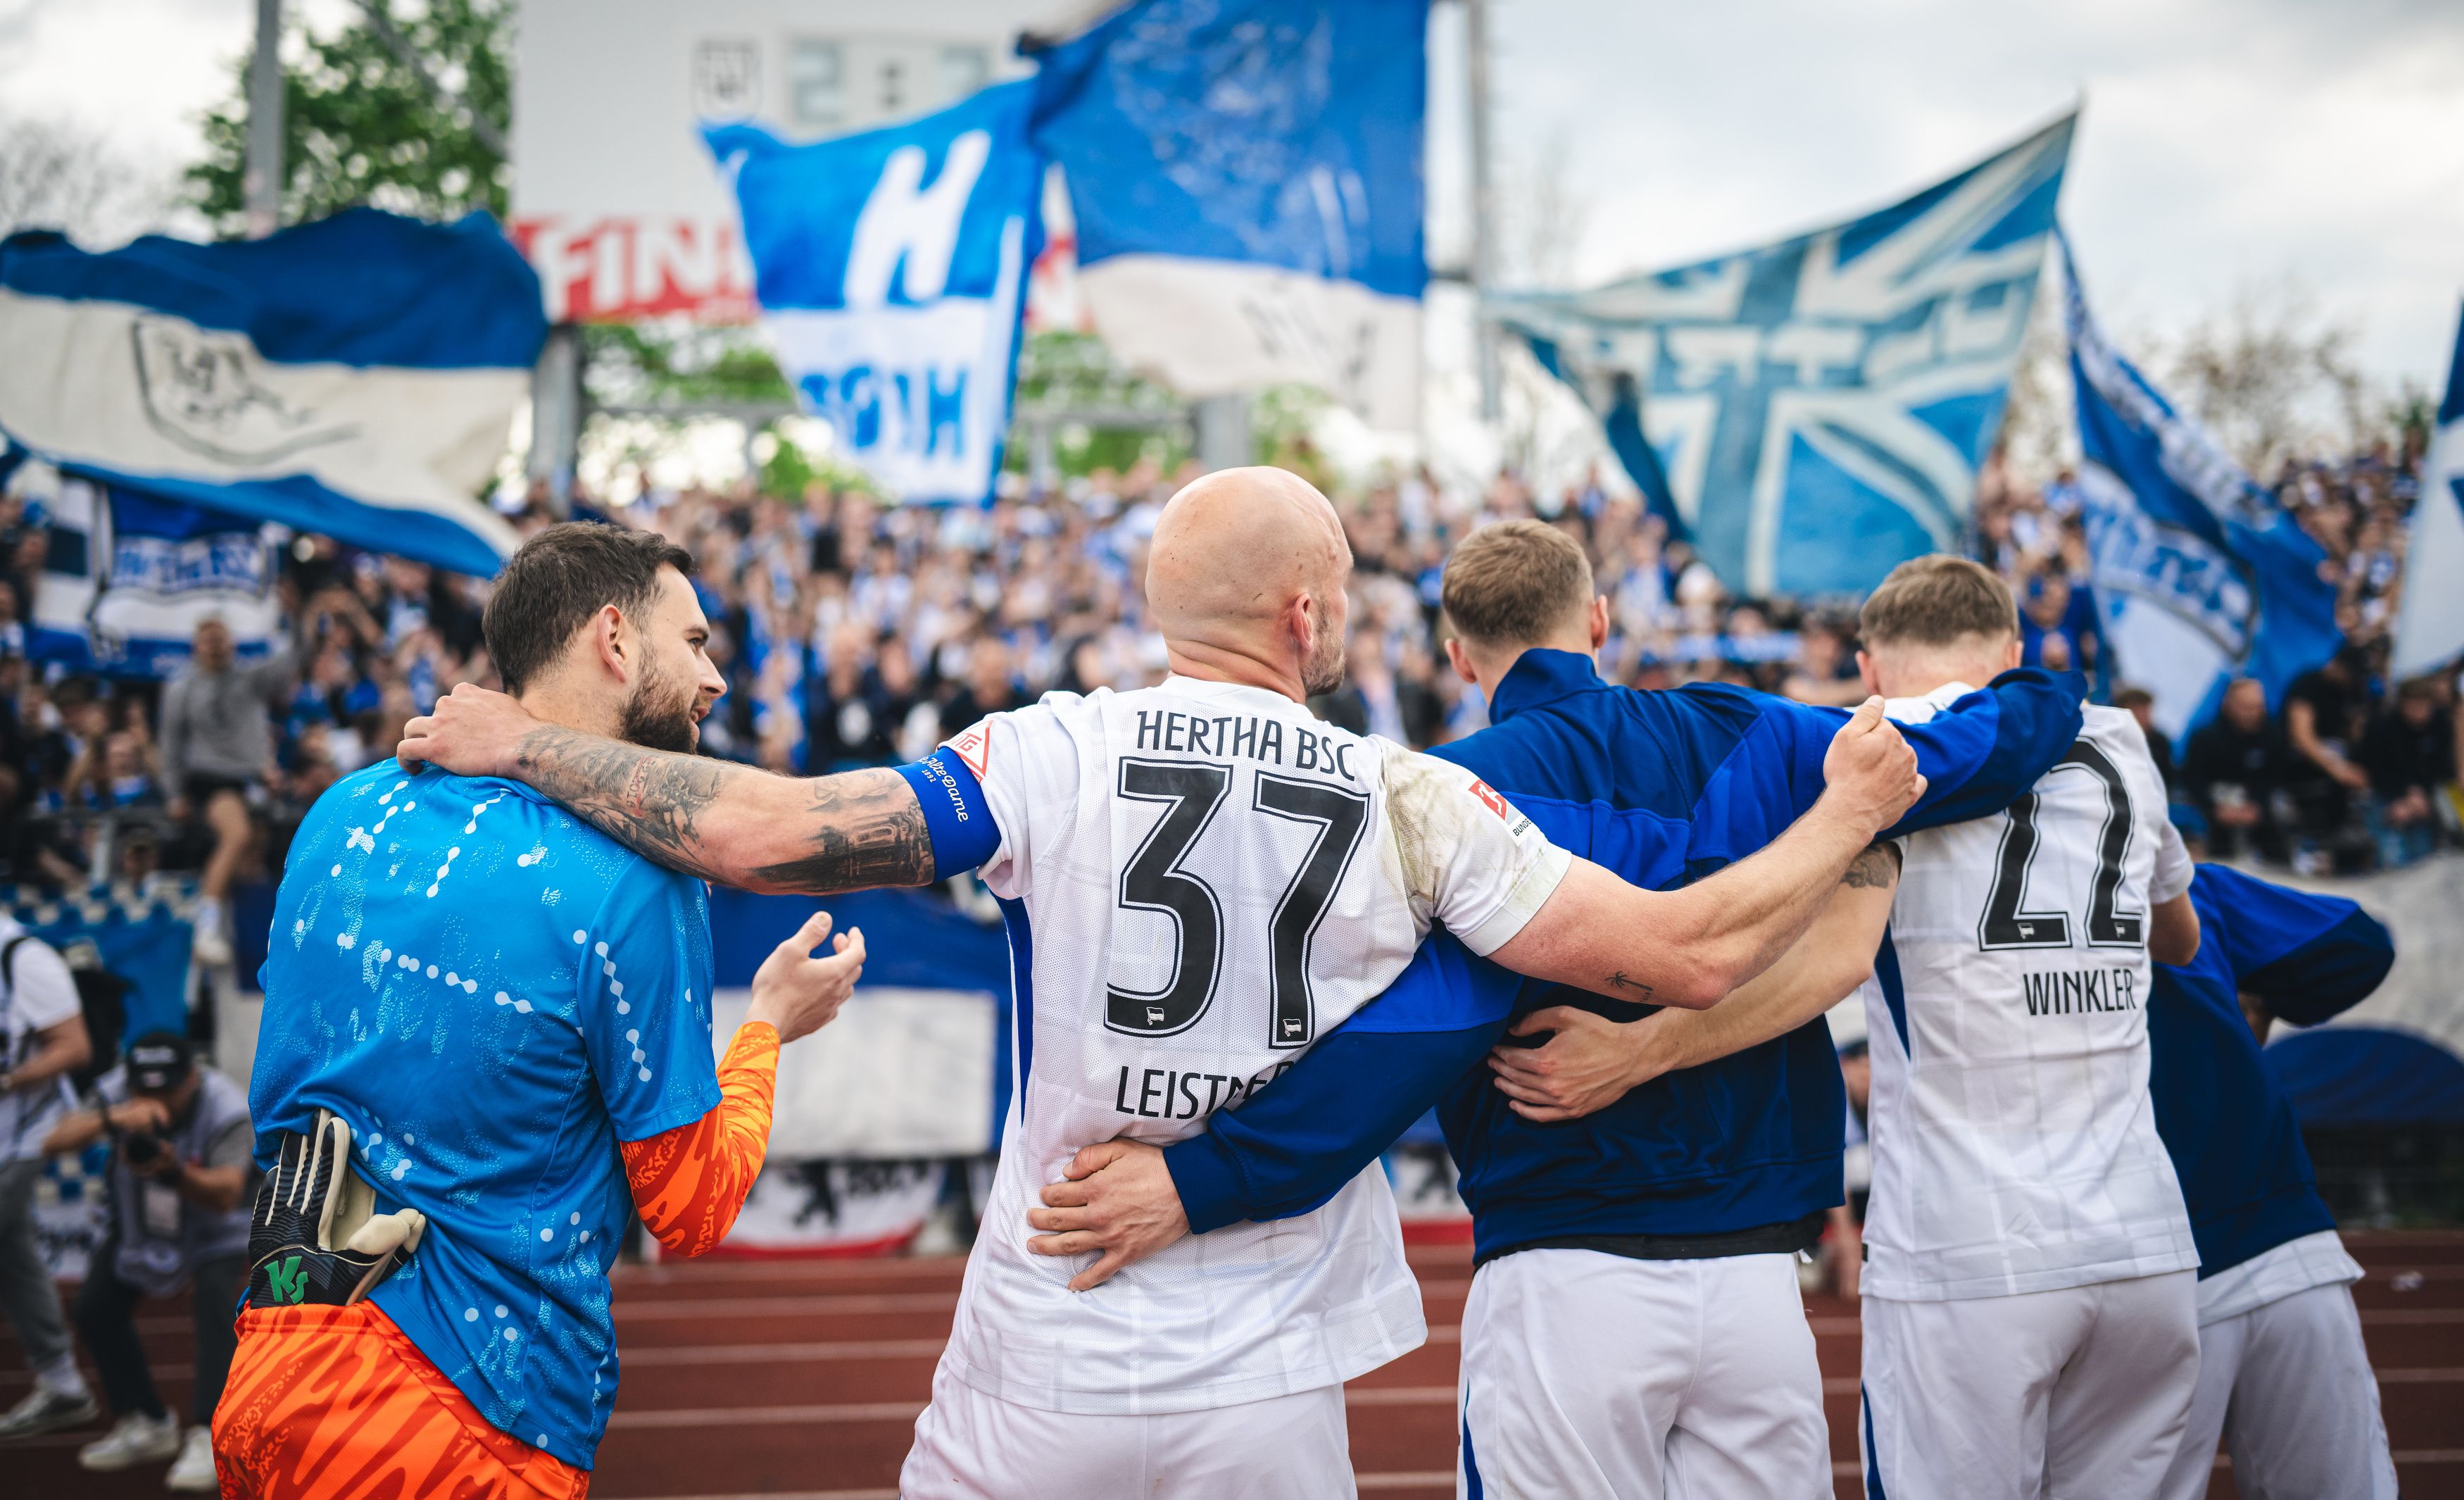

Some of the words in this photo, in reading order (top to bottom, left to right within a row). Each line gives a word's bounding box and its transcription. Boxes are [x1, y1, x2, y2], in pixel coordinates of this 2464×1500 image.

[921, 769, 937, 783] 1892
[1137, 710, 1282, 765] HERTHA
[1295, 727, 1355, 782] BSC
[927, 757, 947, 777] Alte
[941, 775, 969, 823] Dame
[1978, 735, 2144, 951] 22
[1103, 756, 1370, 1049] 37
[2023, 968, 2137, 1016] WINKLER
